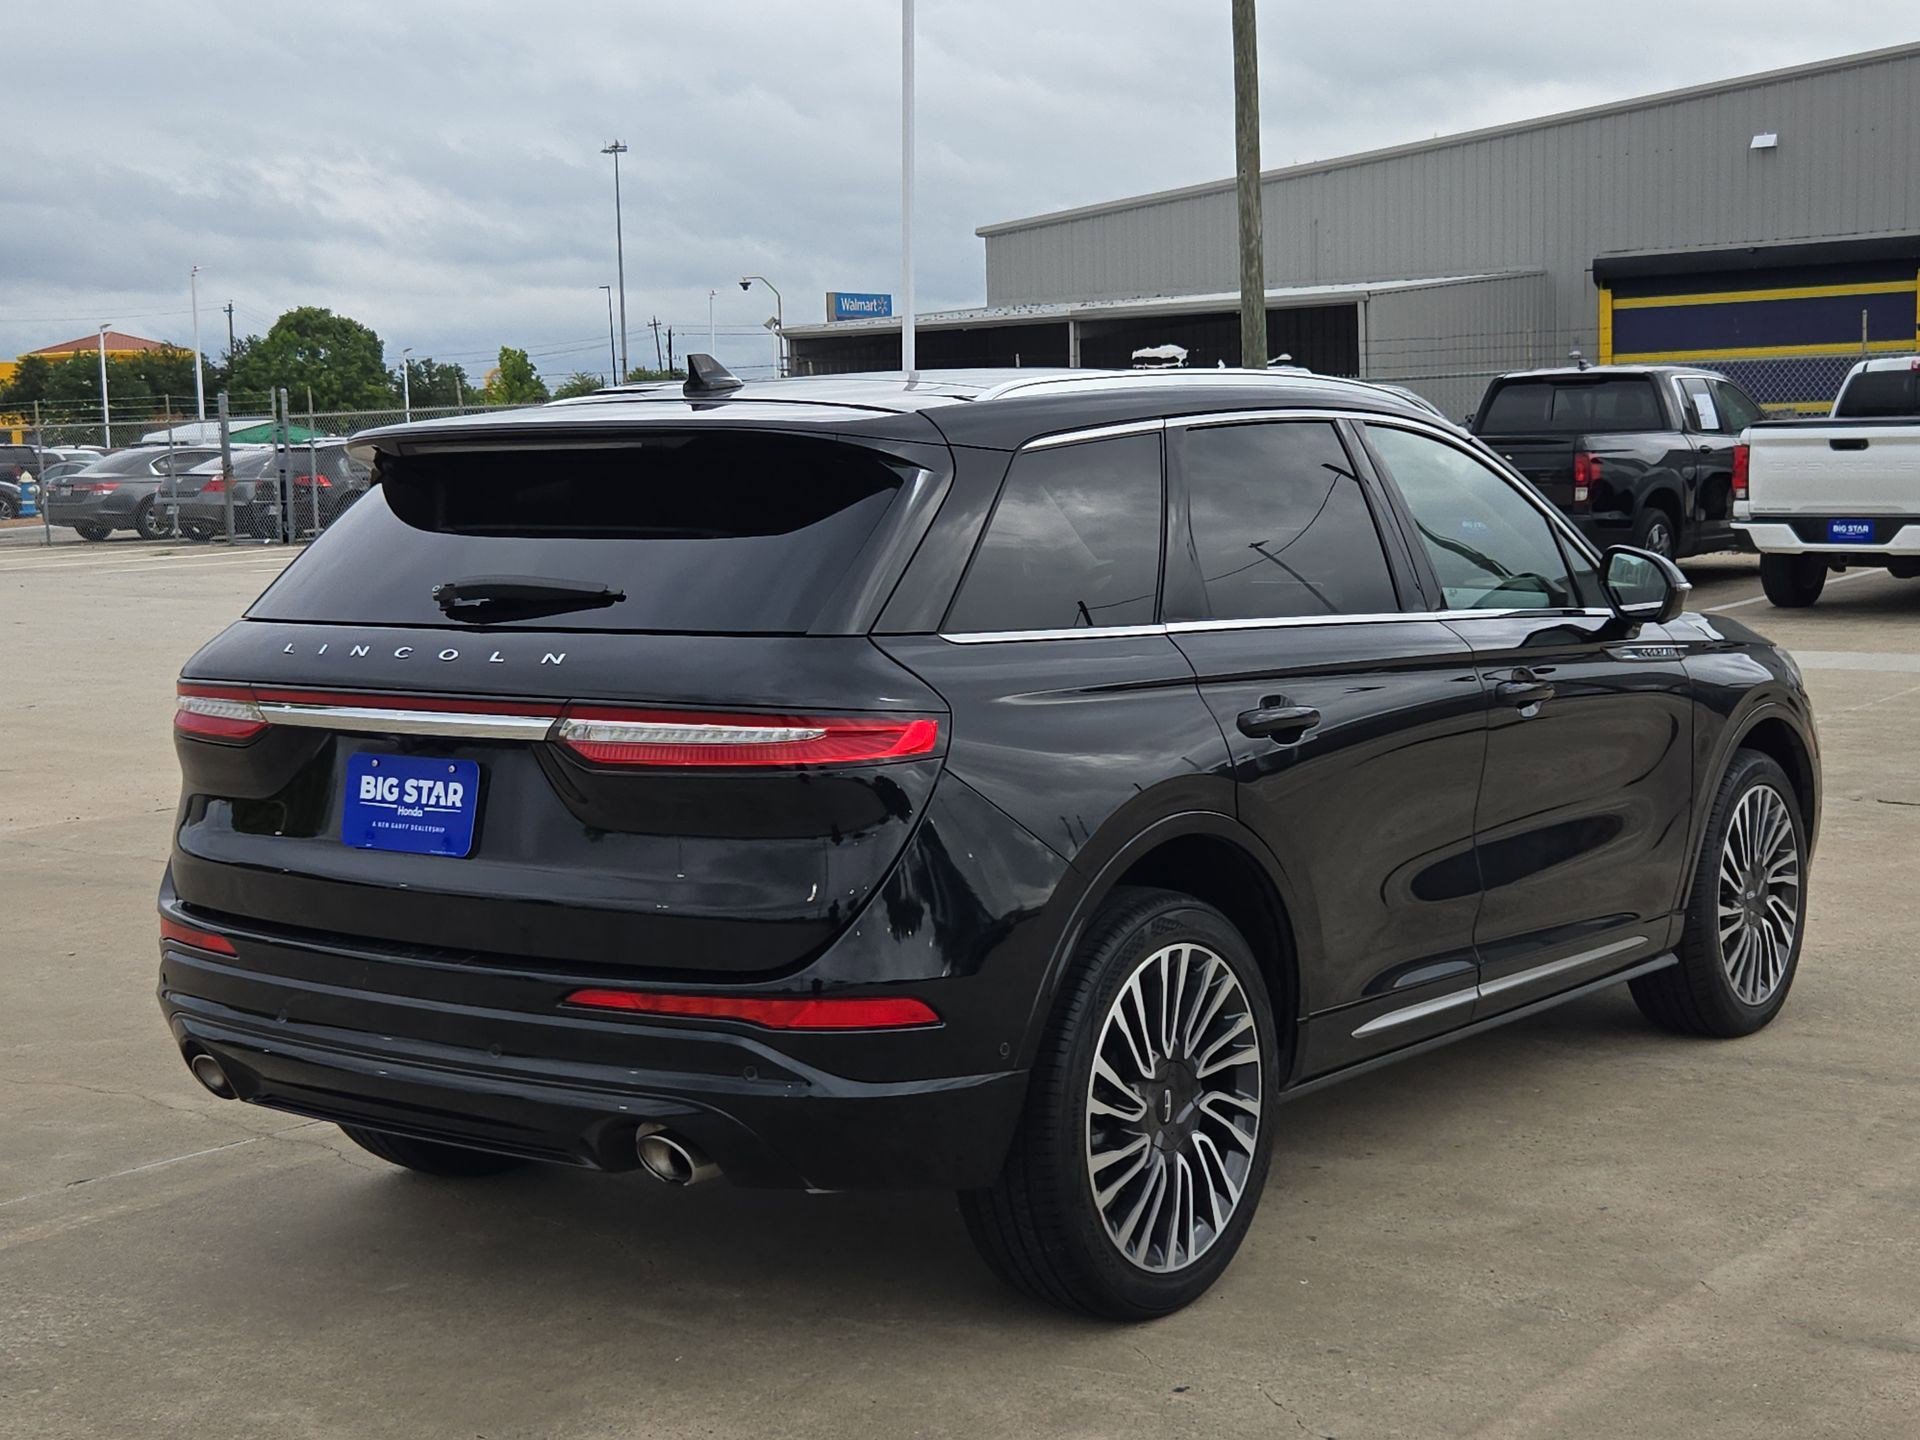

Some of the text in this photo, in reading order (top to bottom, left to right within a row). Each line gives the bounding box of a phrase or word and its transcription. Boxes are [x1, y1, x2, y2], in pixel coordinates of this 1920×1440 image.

[840, 298, 877, 312] Walmart
[1832, 524, 1847, 533] BIG
[1848, 524, 1869, 534] STAR
[284, 643, 567, 665] LINCOLN
[360, 775, 464, 807] BIG STAR
[397, 805, 423, 817] Honda
